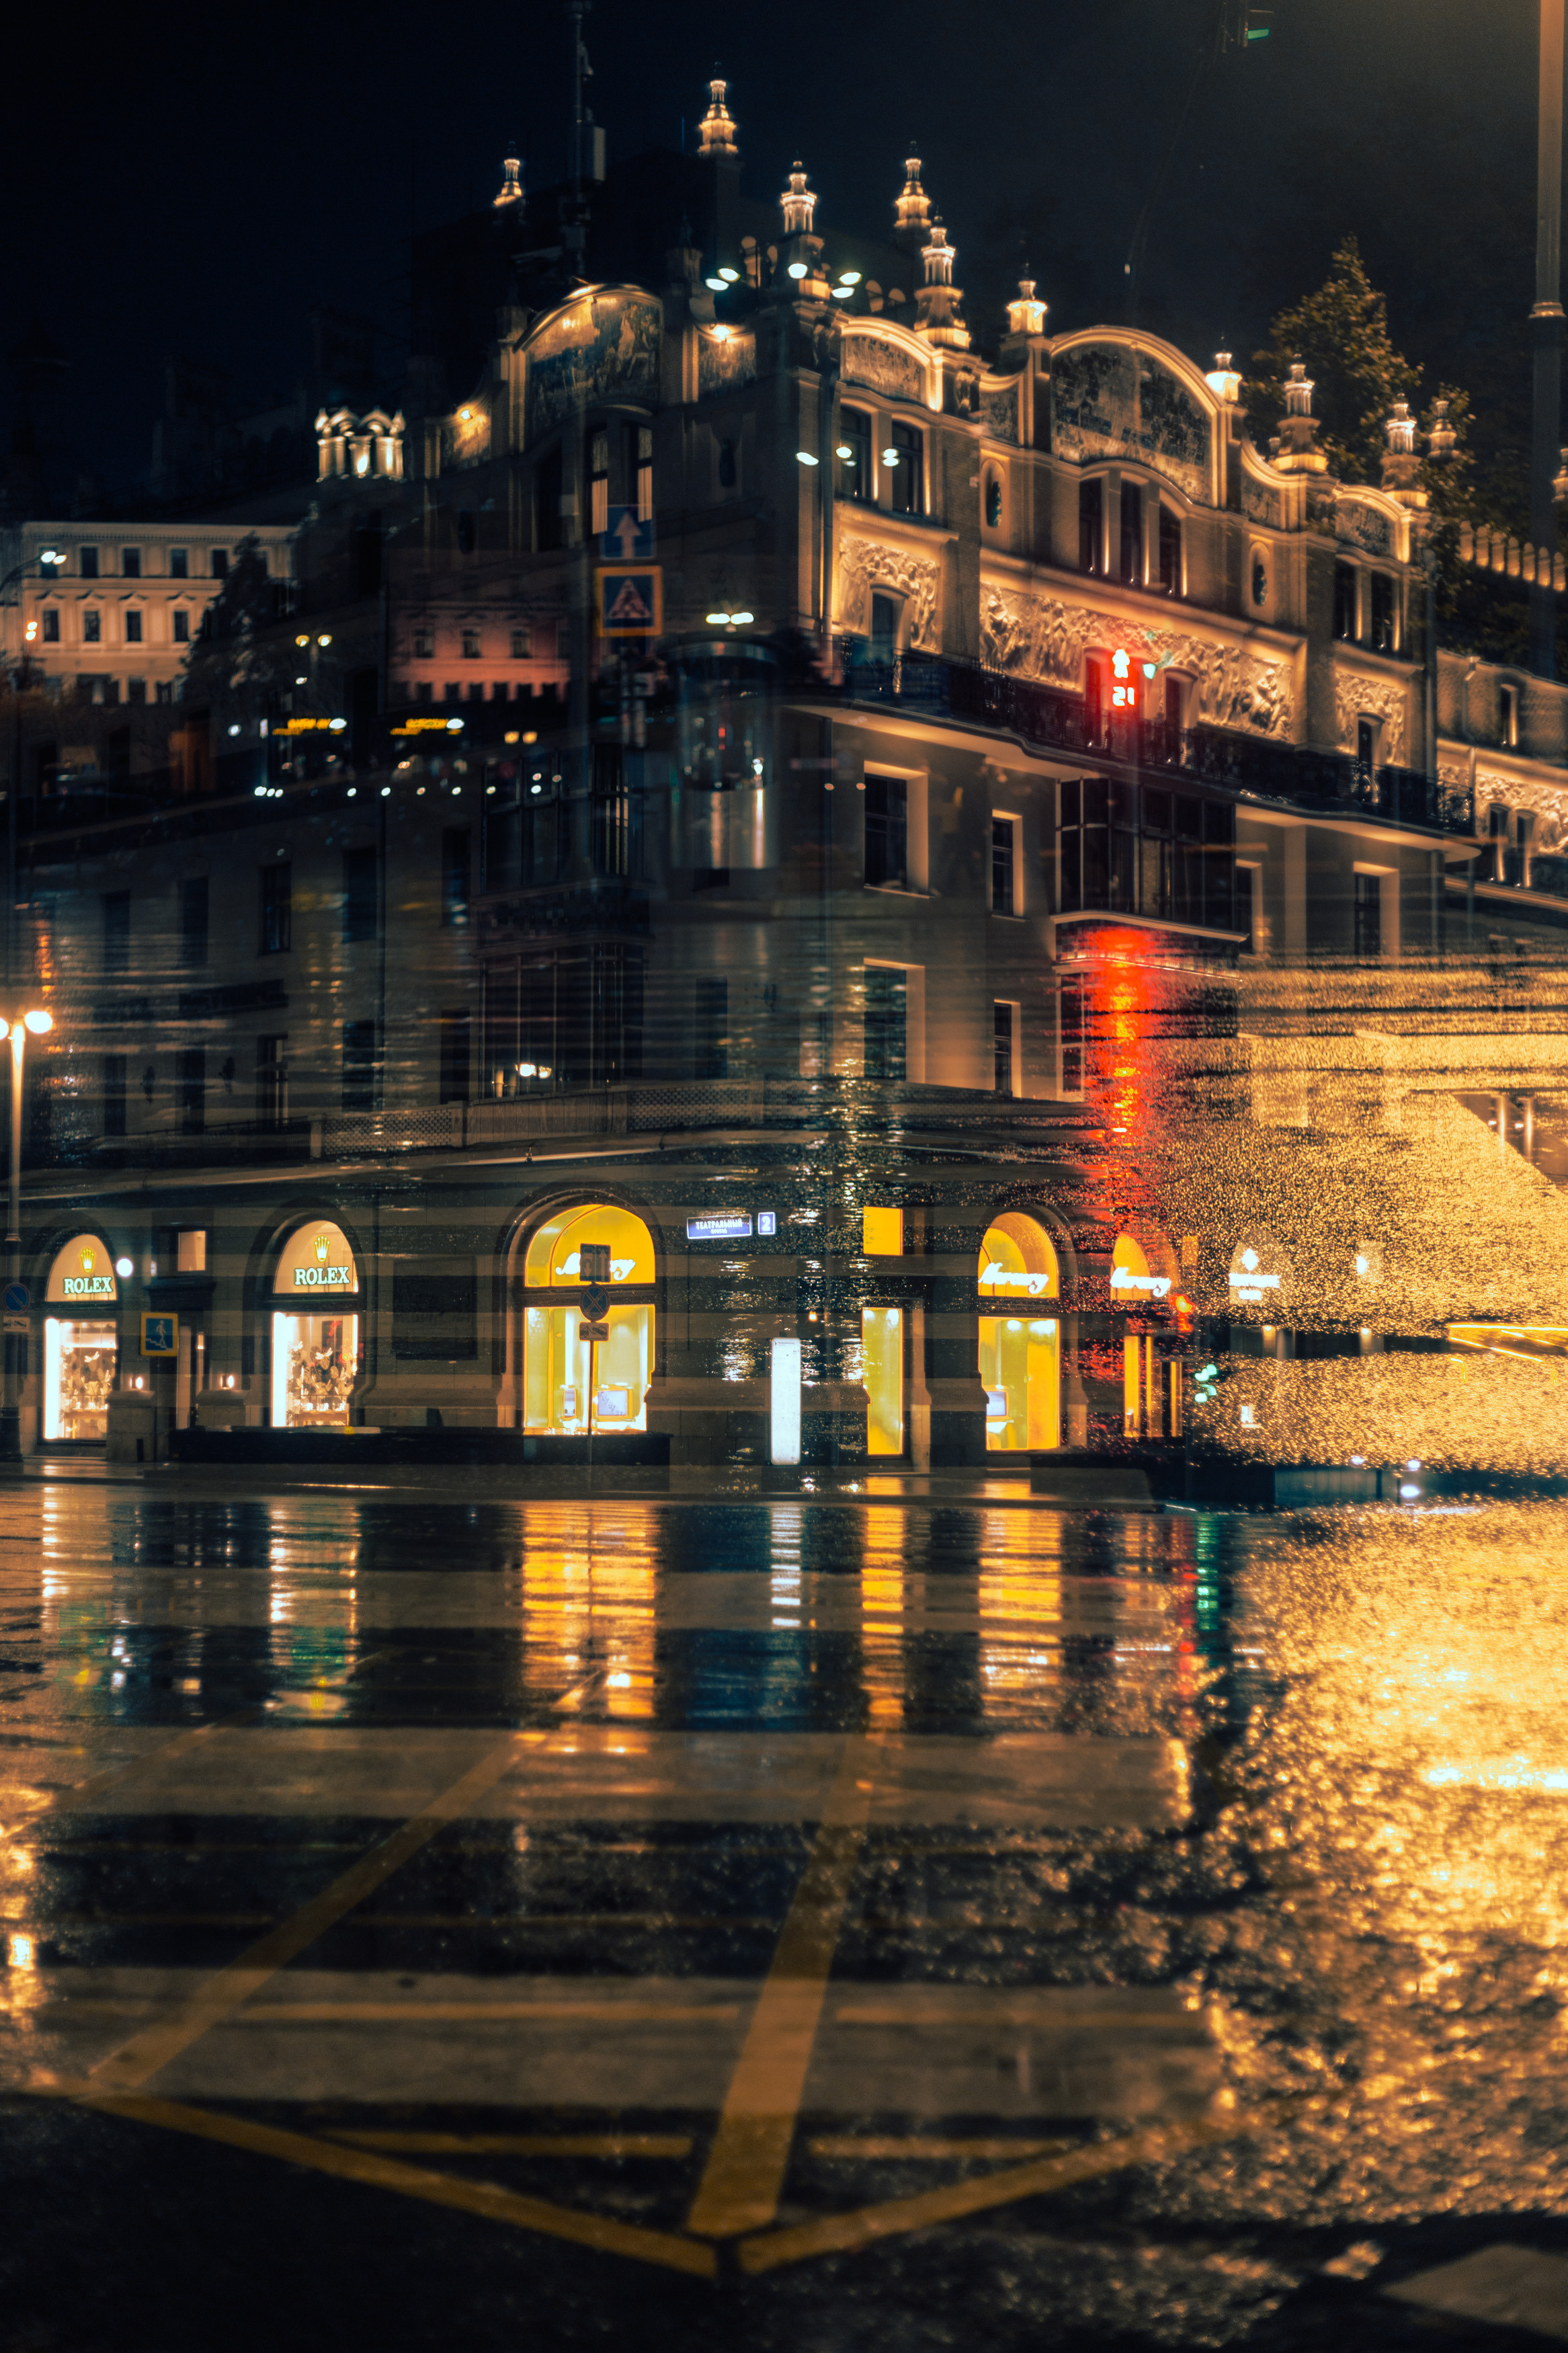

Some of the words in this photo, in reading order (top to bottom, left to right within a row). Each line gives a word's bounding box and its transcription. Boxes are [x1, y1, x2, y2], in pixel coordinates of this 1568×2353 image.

[761, 1215, 771, 1232] 2
[294, 1267, 350, 1285] ROLEX
[64, 1277, 112, 1293] ROLEX
